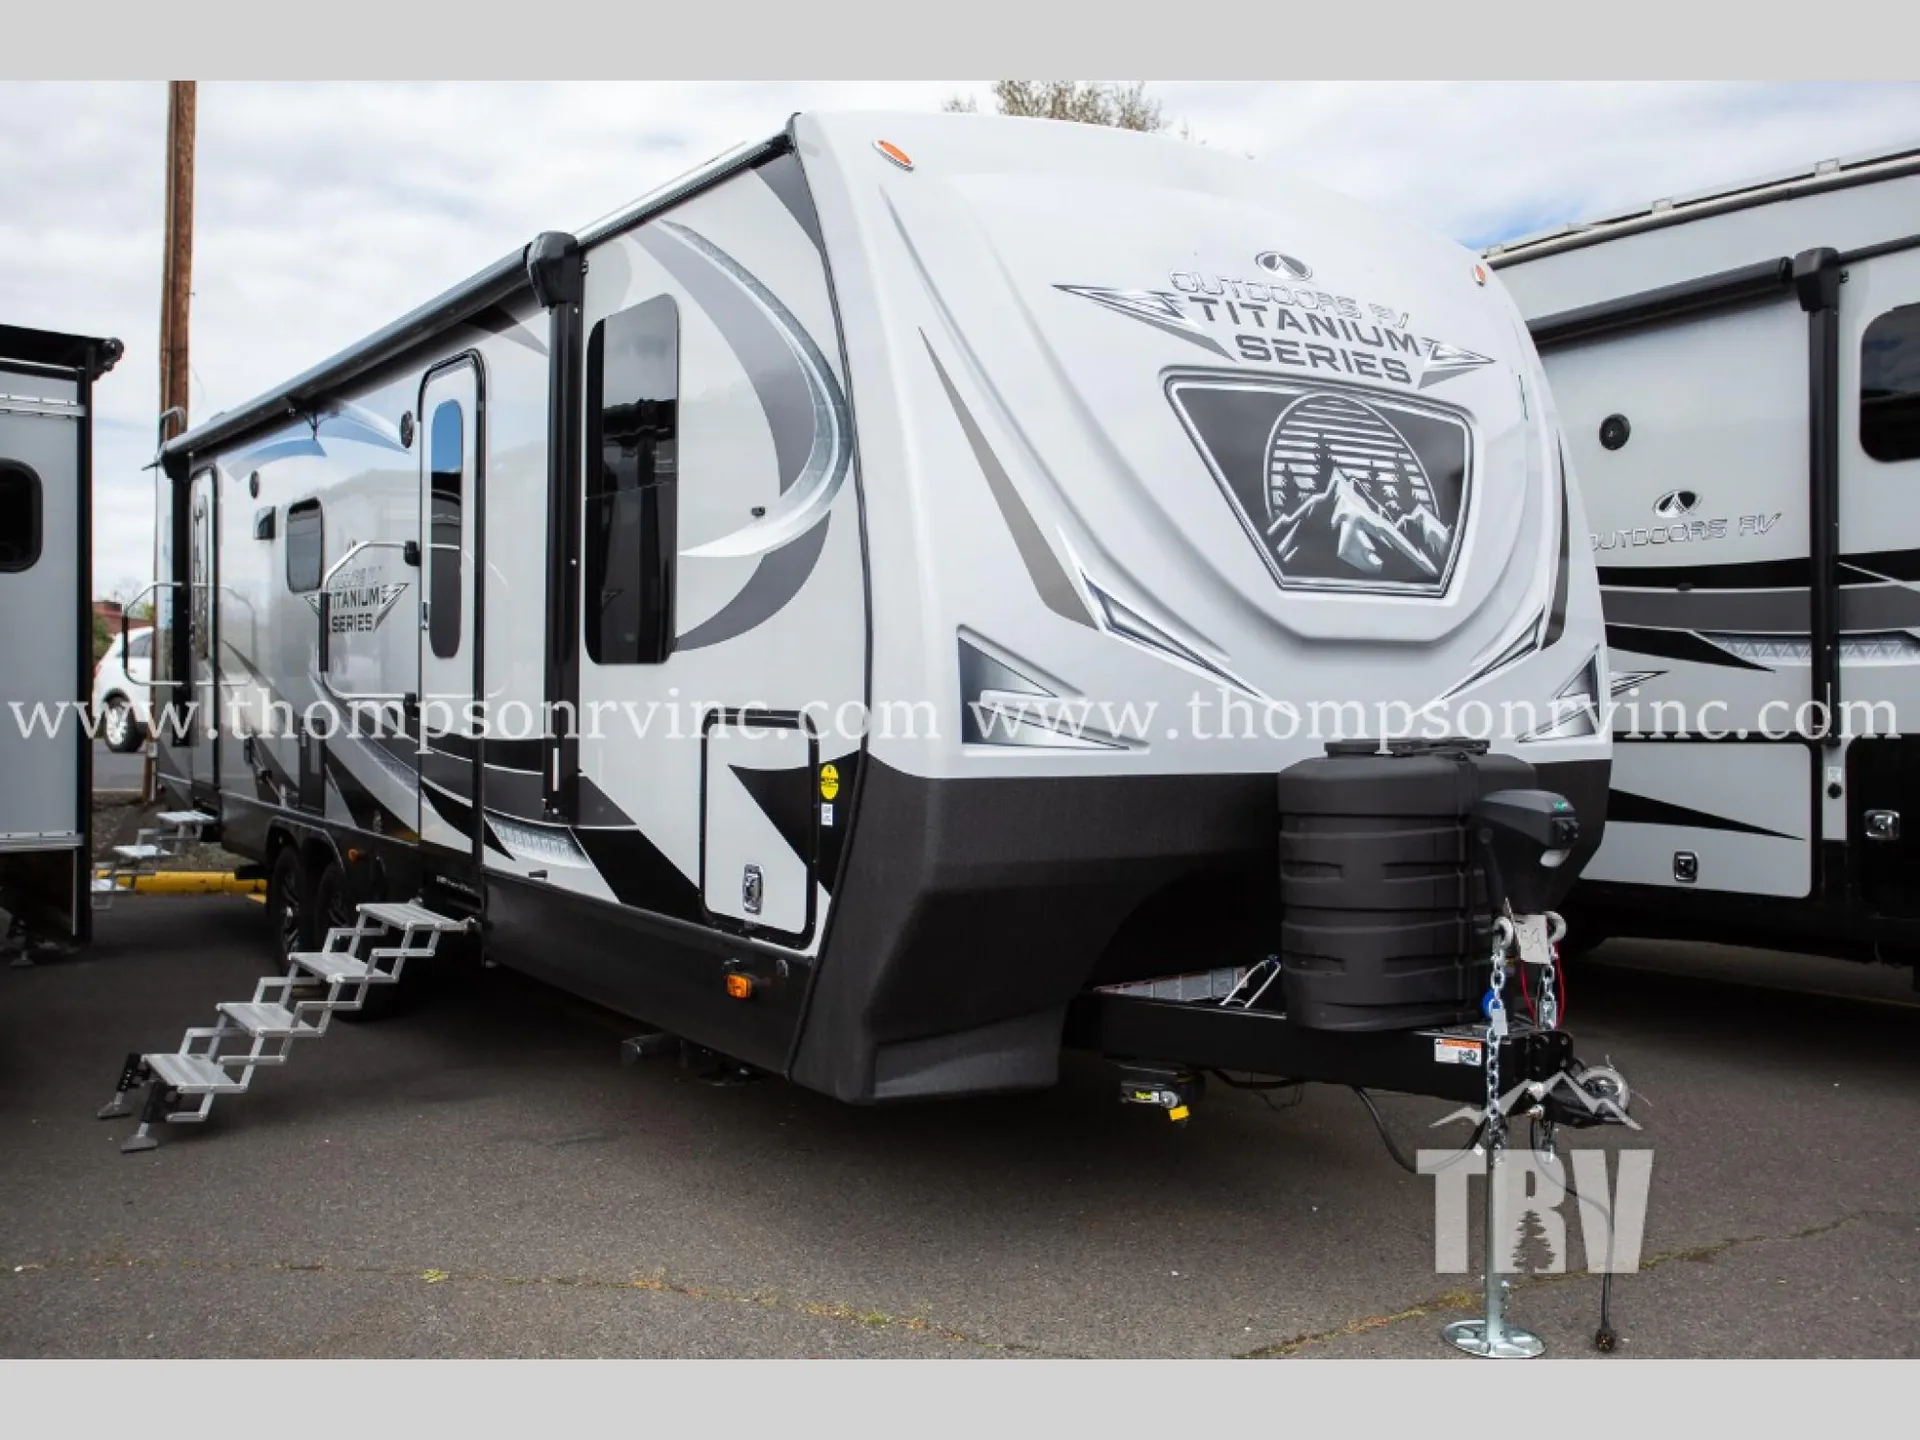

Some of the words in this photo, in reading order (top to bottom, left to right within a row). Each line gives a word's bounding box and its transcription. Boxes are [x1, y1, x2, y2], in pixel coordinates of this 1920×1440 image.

[1169, 270, 1362, 320] OUTDOORS
[1189, 296, 1421, 357] TITANIUM
[1235, 333, 1412, 384] SERIES
[1739, 512, 1782, 537] RV
[328, 586, 380, 609] ITANIUM
[331, 612, 372, 632] SERIES
